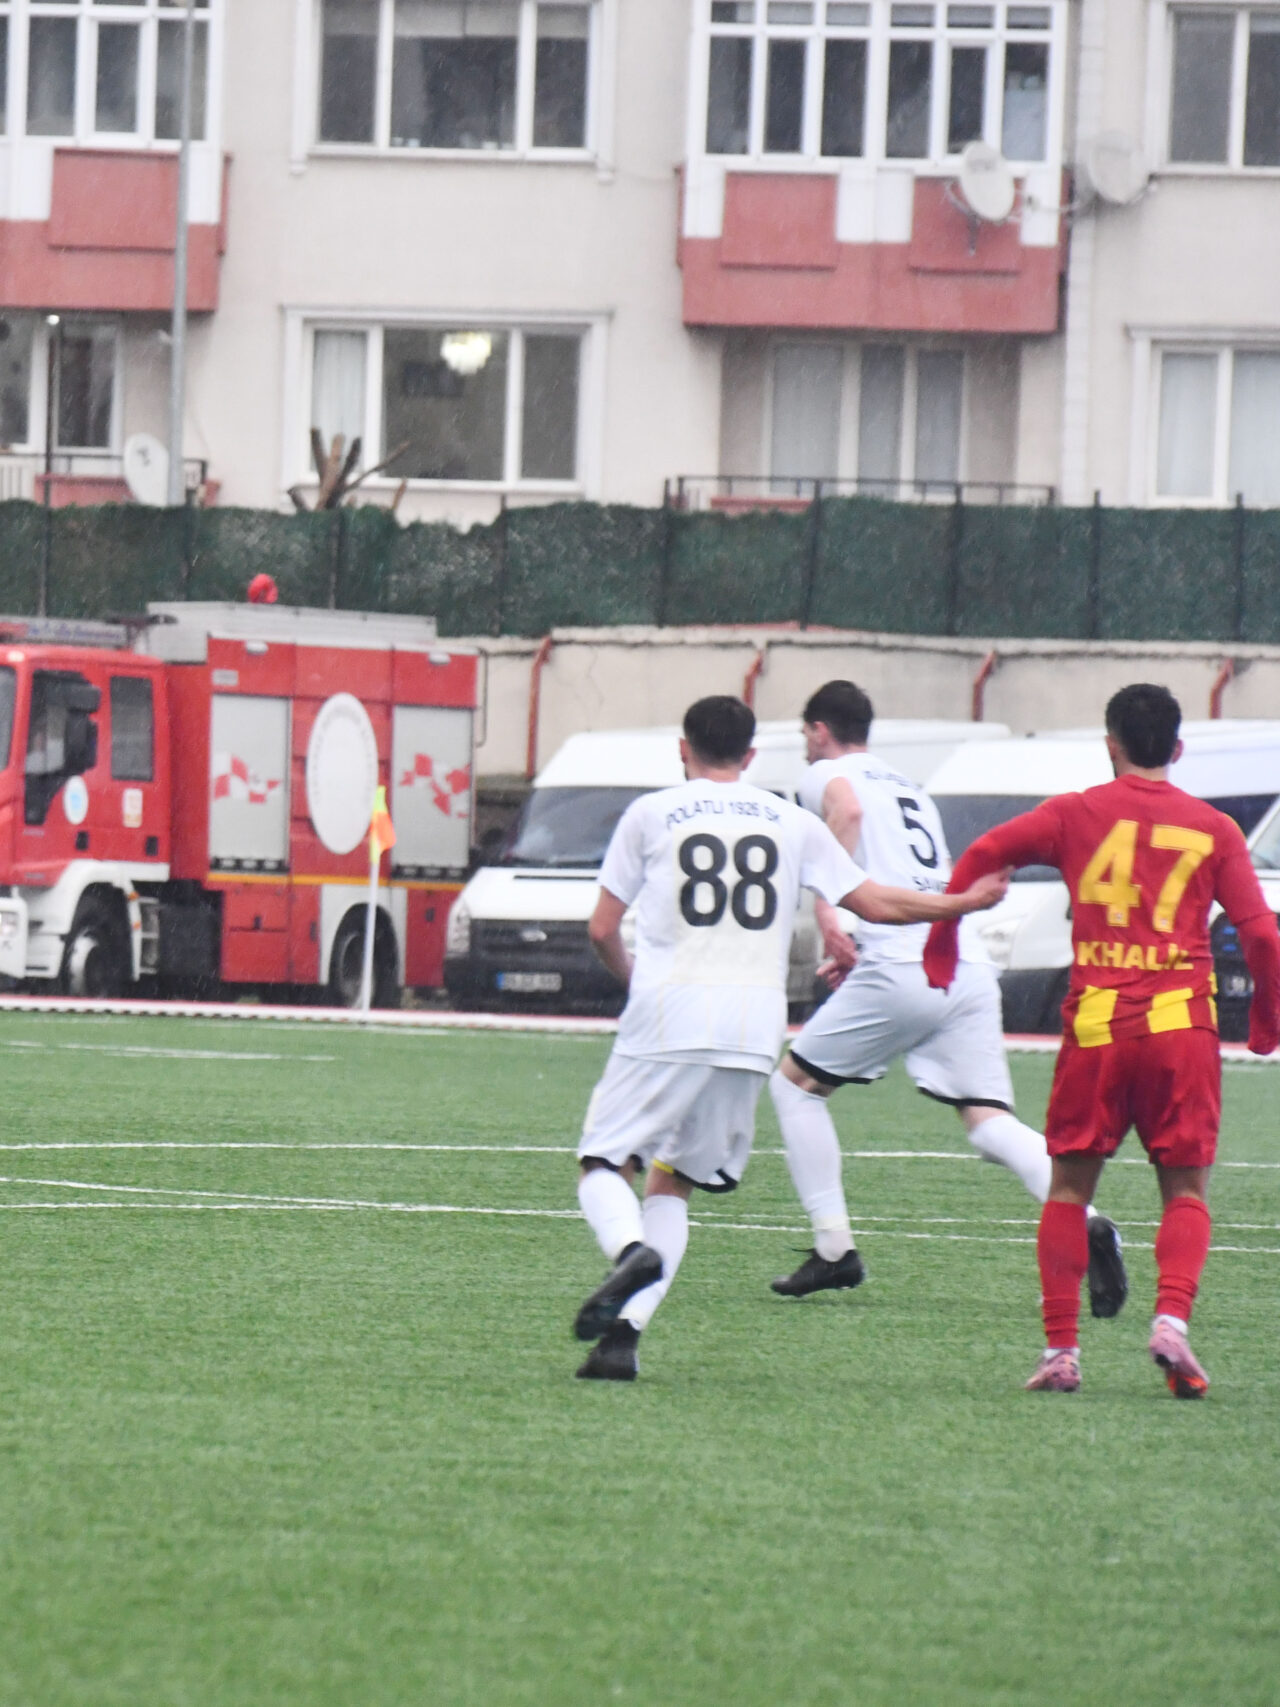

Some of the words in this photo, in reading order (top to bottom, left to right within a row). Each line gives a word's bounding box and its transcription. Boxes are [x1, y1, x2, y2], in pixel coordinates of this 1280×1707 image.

[896, 796, 937, 869] 5
[1078, 819, 1214, 934] 47
[678, 833, 779, 931] 88
